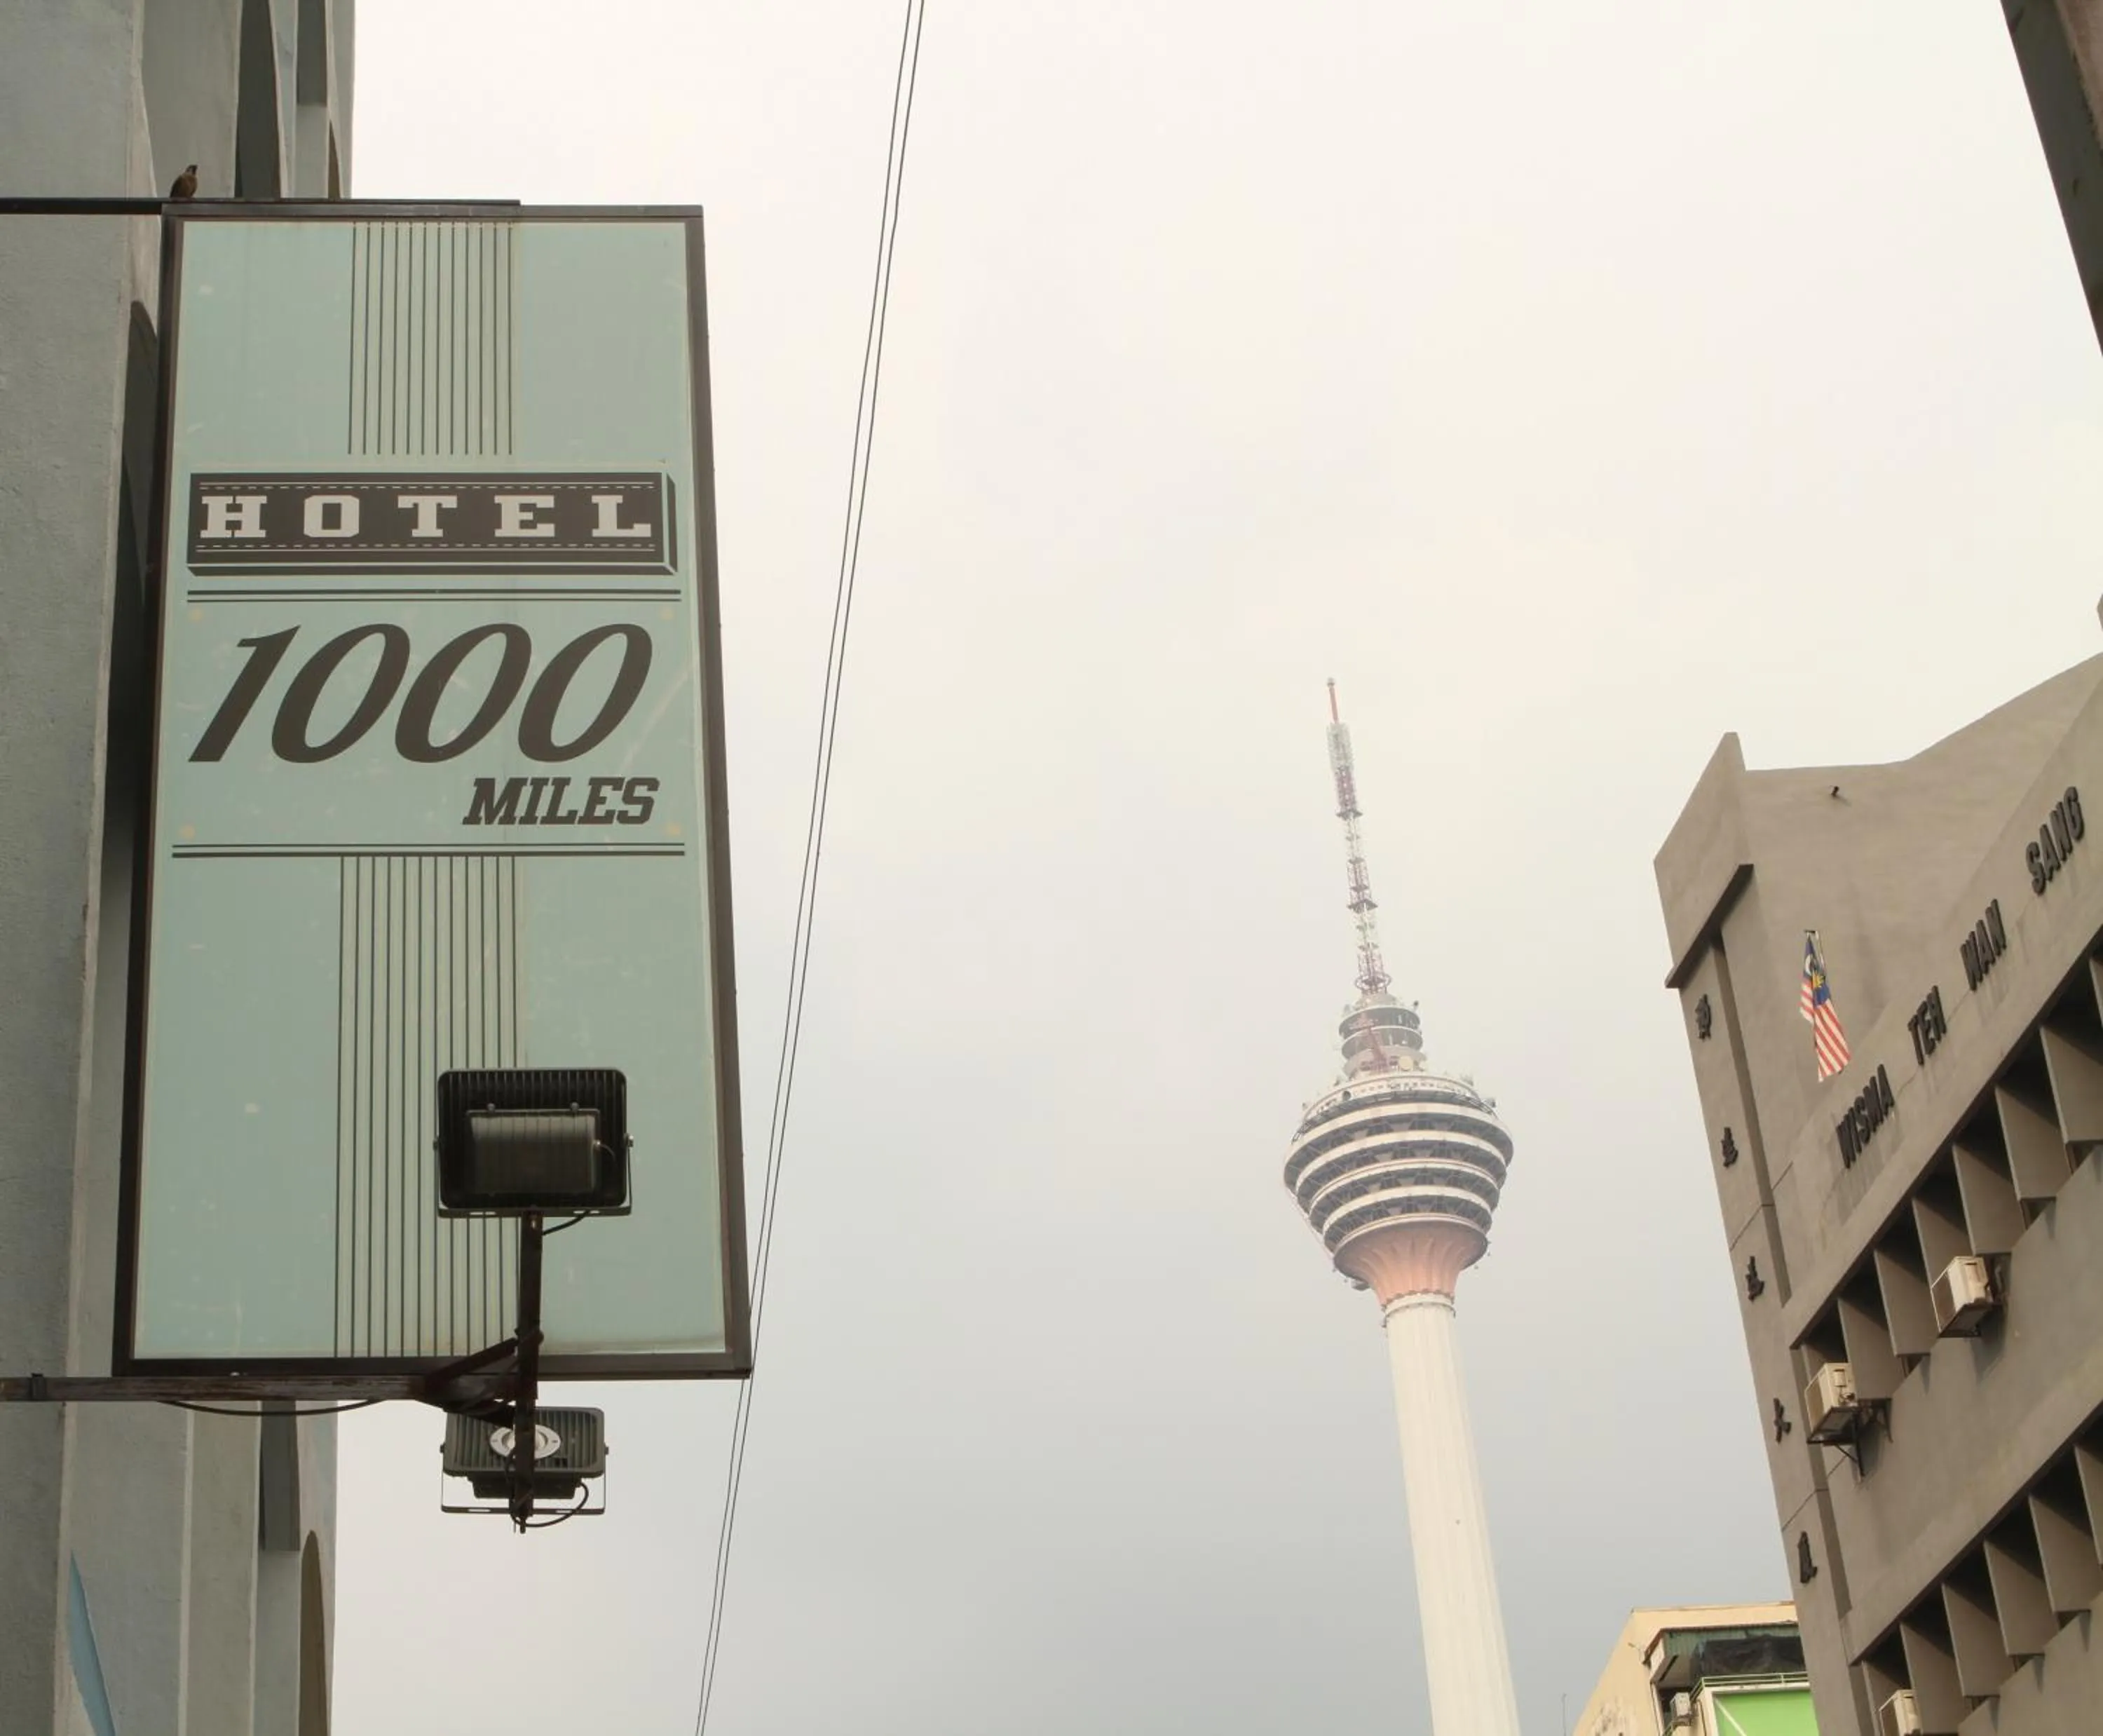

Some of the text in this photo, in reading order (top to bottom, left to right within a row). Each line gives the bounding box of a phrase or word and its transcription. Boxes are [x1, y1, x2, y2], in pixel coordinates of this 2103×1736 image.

[200, 495, 652, 538] HOTEL
[188, 623, 653, 764] 1000
[461, 777, 660, 825] MILES
[1835, 786, 2085, 1169] WISMA TEH WAN SANG
